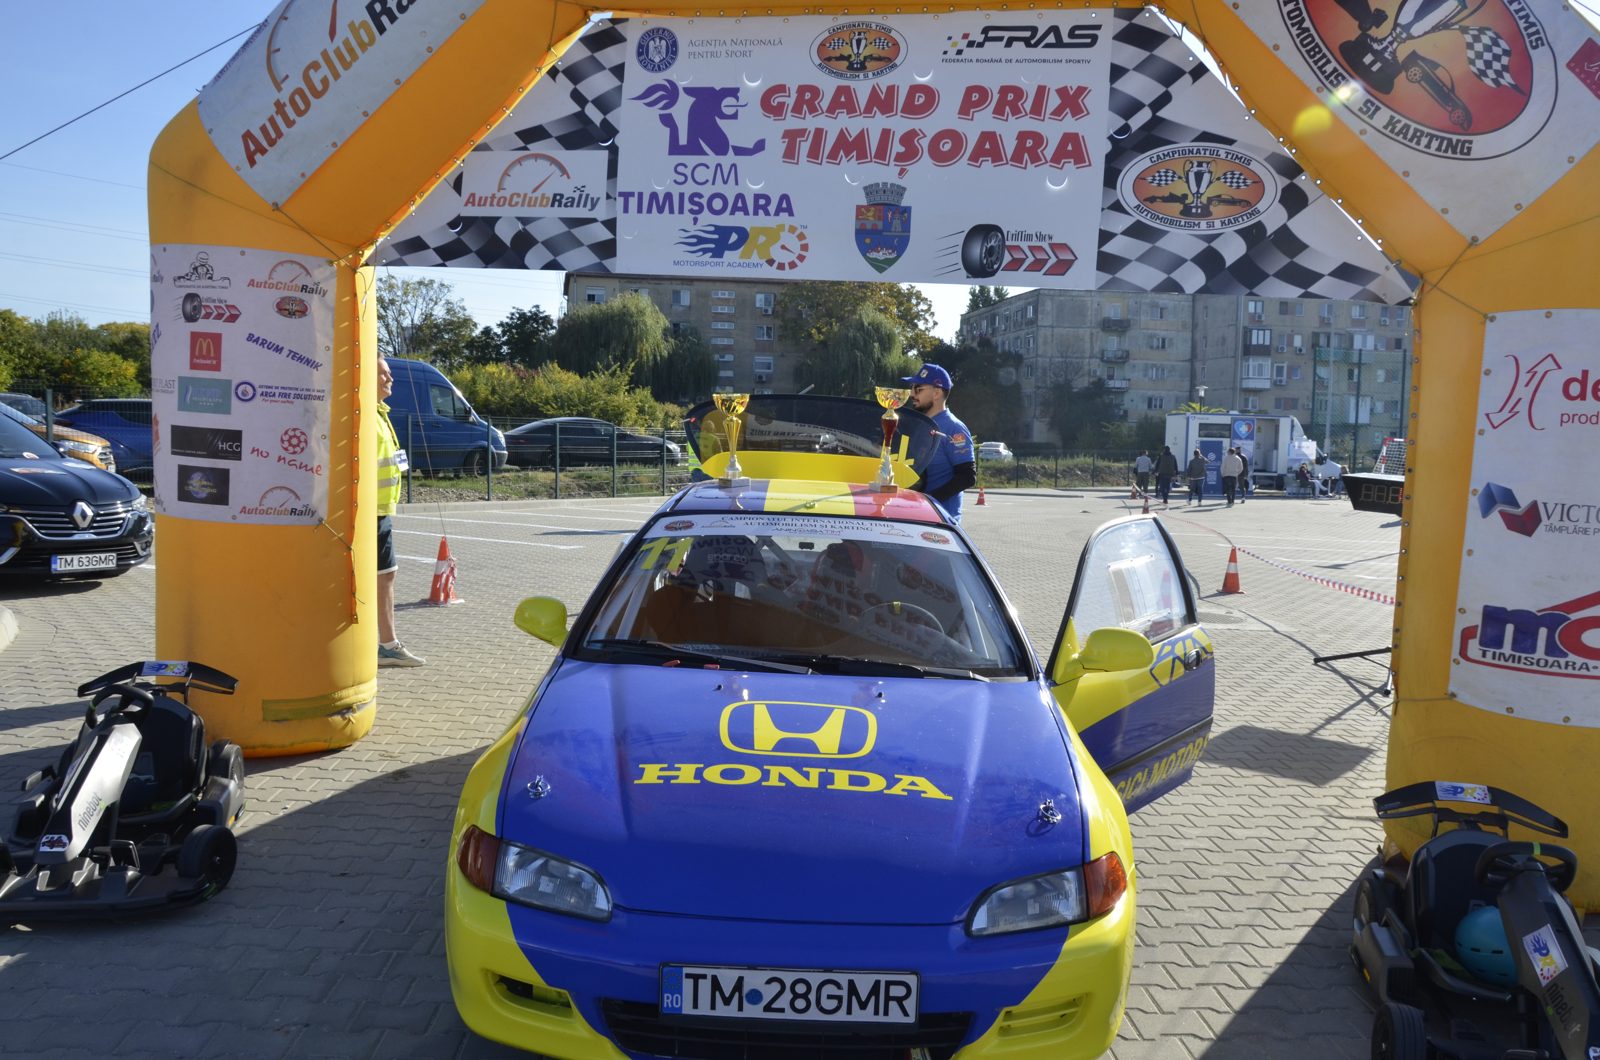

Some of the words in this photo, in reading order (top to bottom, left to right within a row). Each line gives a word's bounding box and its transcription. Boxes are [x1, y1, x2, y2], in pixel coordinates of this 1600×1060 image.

[640, 29, 676, 45] GUVERNUL
[828, 23, 872, 34] CAMPIONATUL
[875, 25, 892, 34] TIMIS
[977, 24, 1103, 48] FRAS
[688, 51, 722, 59] PENTRU
[724, 49, 754, 59] SPORT
[818, 62, 859, 79] AUTOMOBILISM
[872, 62, 898, 78] KARTING
[760, 84, 940, 121] GRAND
[958, 84, 1090, 122] PRIX
[1358, 99, 1383, 120] SI
[1383, 115, 1473, 157] KARTING
[780, 127, 1093, 179] TIMIȘOARA
[1150, 147, 1221, 164] CAMPIONATUL
[1225, 151, 1253, 167] TIMIS
[673, 163, 740, 187] SCM
[464, 192, 600, 212] AutoClubRally
[618, 191, 795, 225] TIMIȘOARA
[1134, 202, 1201, 229] AUTOMOBILISM
[1206, 219, 1215, 229] SI
[1220, 207, 1261, 228] KARTING
[1035, 231, 1053, 242] Show
[673, 259, 724, 268] MOTORSPORT
[726, 261, 765, 269] ACADEMY
[247, 278, 328, 297] AutoClubRally
[246, 332, 284, 355] BARUM
[286, 347, 324, 372] TEHNIK
[260, 391, 276, 399] ARCA
[278, 392, 292, 400] FIRE
[293, 393, 326, 401] SOLUTIONS
[219, 441, 241, 452] HCG
[240, 505, 316, 518] AutoClubRally
[829, 524, 873, 532] KARTING
[57, 556, 74, 569] TM
[77, 554, 115, 568] 63GMR
[639, 537, 693, 571] 11
[1478, 648, 1592, 673] TIMISOARA
[634, 763, 954, 801] HONDA
[78, 792, 103, 831] ninebot
[663, 993, 681, 1009] RO
[684, 972, 745, 1012] TM
[762, 976, 913, 1018] 28GMR
